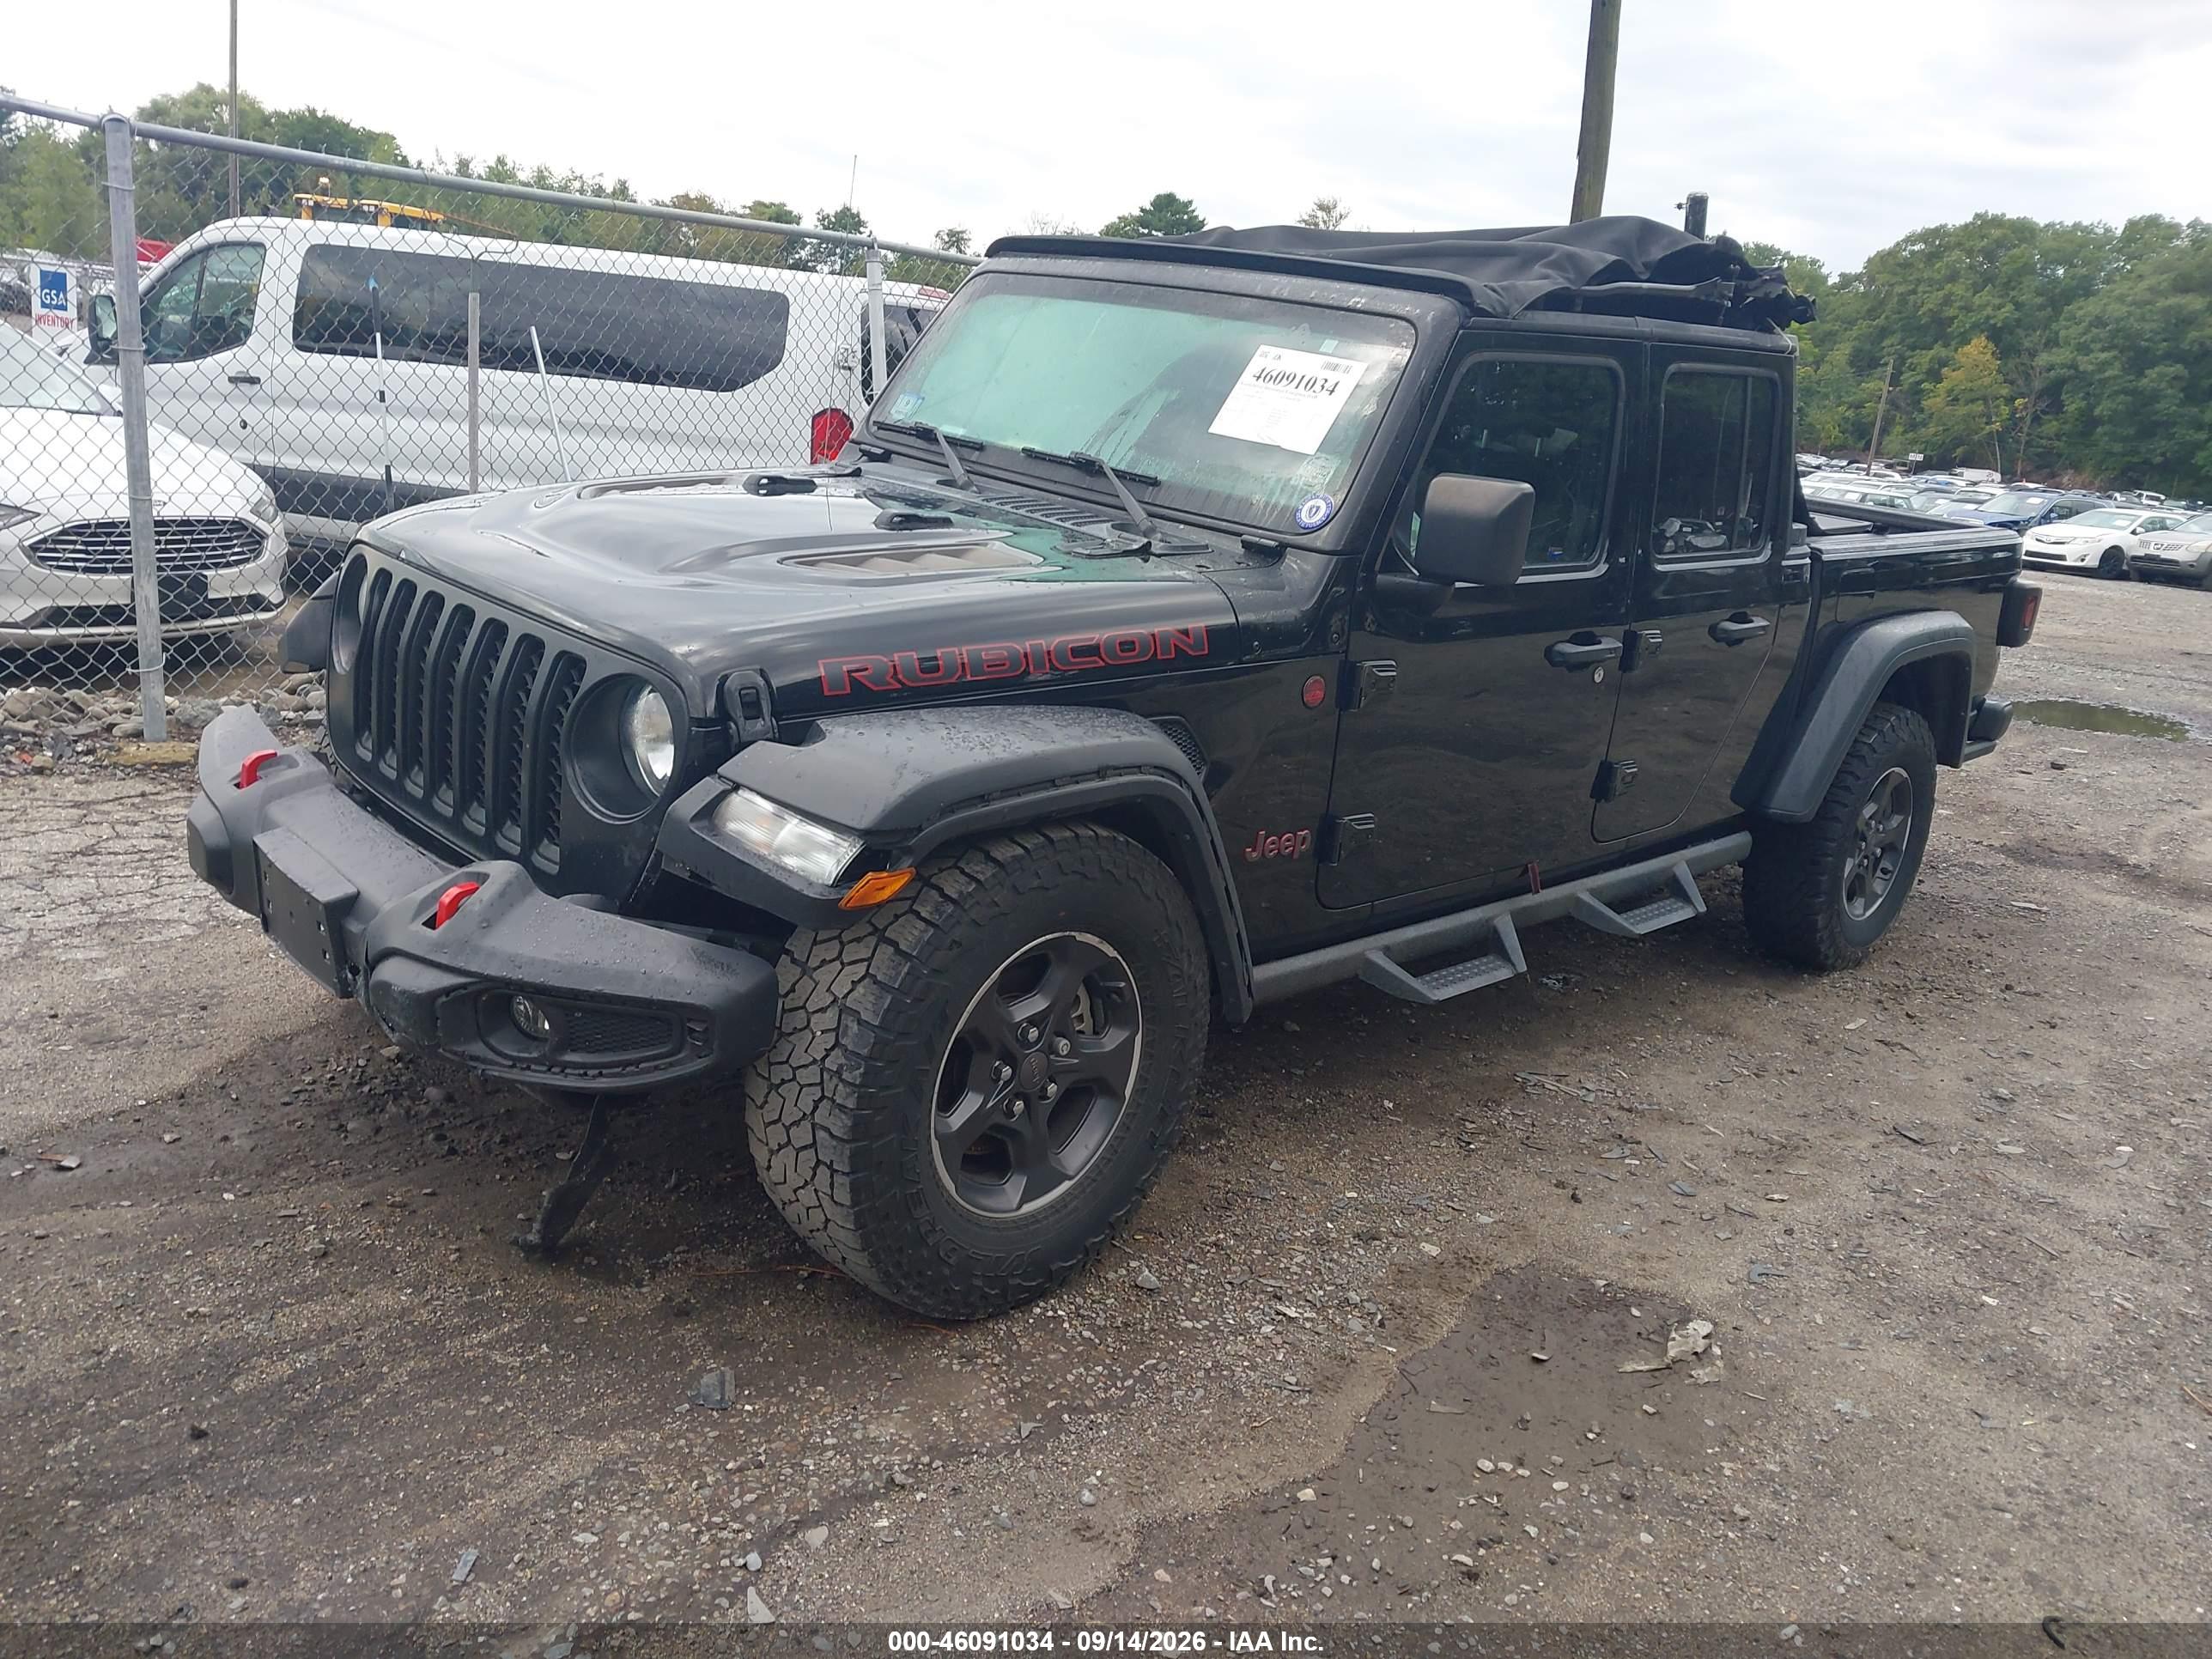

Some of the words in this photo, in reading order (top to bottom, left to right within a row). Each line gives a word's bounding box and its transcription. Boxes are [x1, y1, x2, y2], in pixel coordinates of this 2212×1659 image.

[41, 289, 66, 307] GSA
[35, 313, 75, 329] INVENTORY
[1253, 366, 1340, 396] 46091034
[817, 624, 1209, 696] RUBICON
[1243, 829, 1311, 862] Jeep
